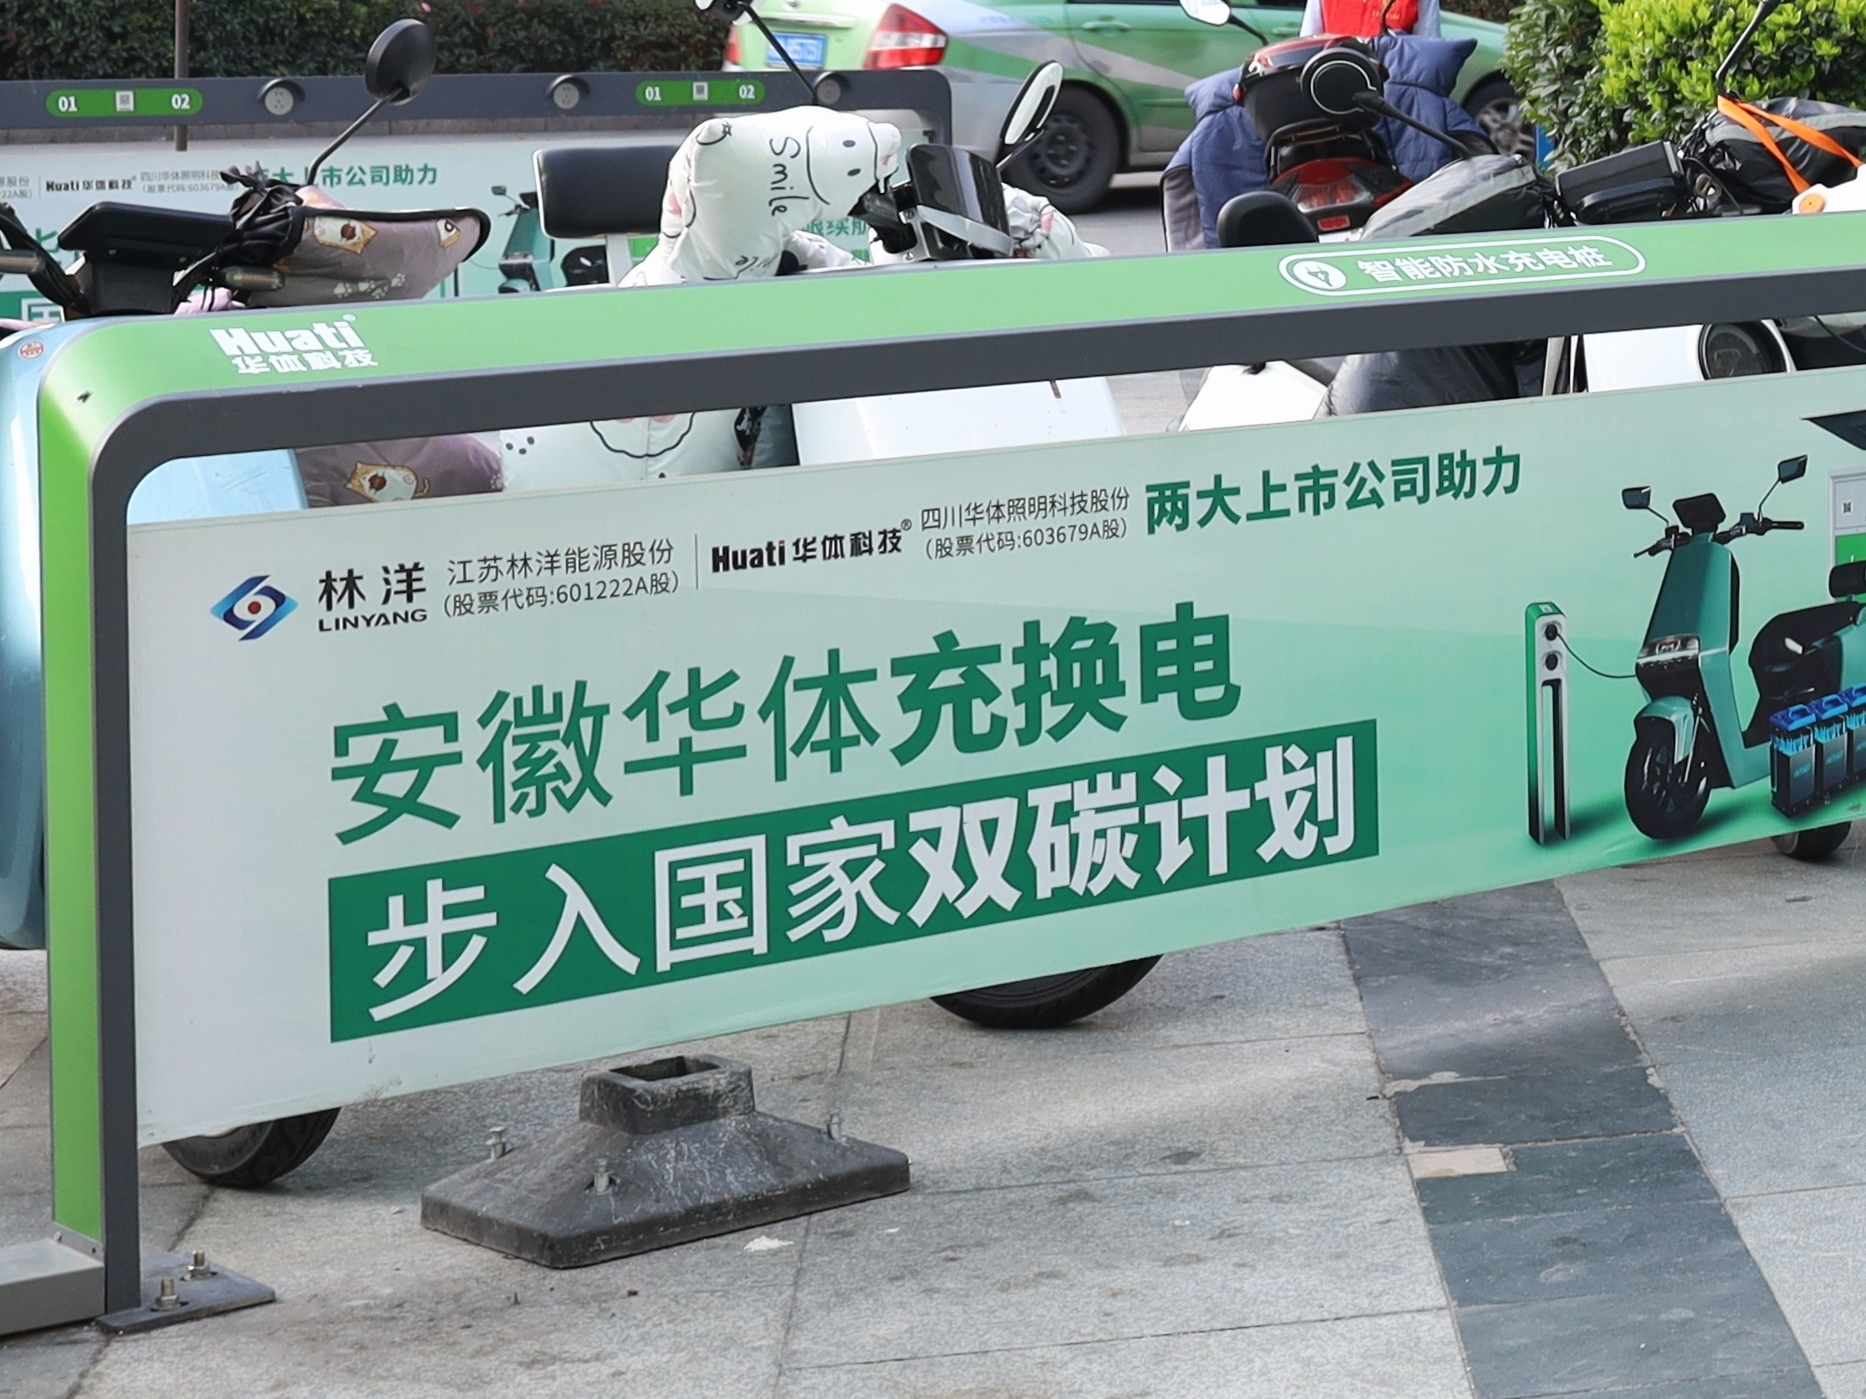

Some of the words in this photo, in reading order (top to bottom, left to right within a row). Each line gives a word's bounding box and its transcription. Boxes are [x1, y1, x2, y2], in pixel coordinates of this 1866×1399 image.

[58, 95, 78, 112] 01
[171, 93, 191, 110] 02
[645, 86, 662, 101] 01
[738, 84, 756, 100] 02
[768, 135, 811, 217] Smile
[1355, 245, 1614, 284] 智能防水充电桩
[210, 320, 366, 358] Huati
[230, 350, 379, 376] 华体科技
[920, 485, 1131, 532] 四川华体照明科技股份
[1144, 444, 1523, 535] 两大上市公司助力
[447, 538, 675, 586] 江苏林洋能源股份
[711, 539, 786, 575] Huati
[318, 561, 428, 613] 林洋
[318, 608, 428, 633] LINYANG
[330, 600, 1243, 846] 安徽华体充换电
[366, 734, 1357, 1022] 步入国家双碳计划
